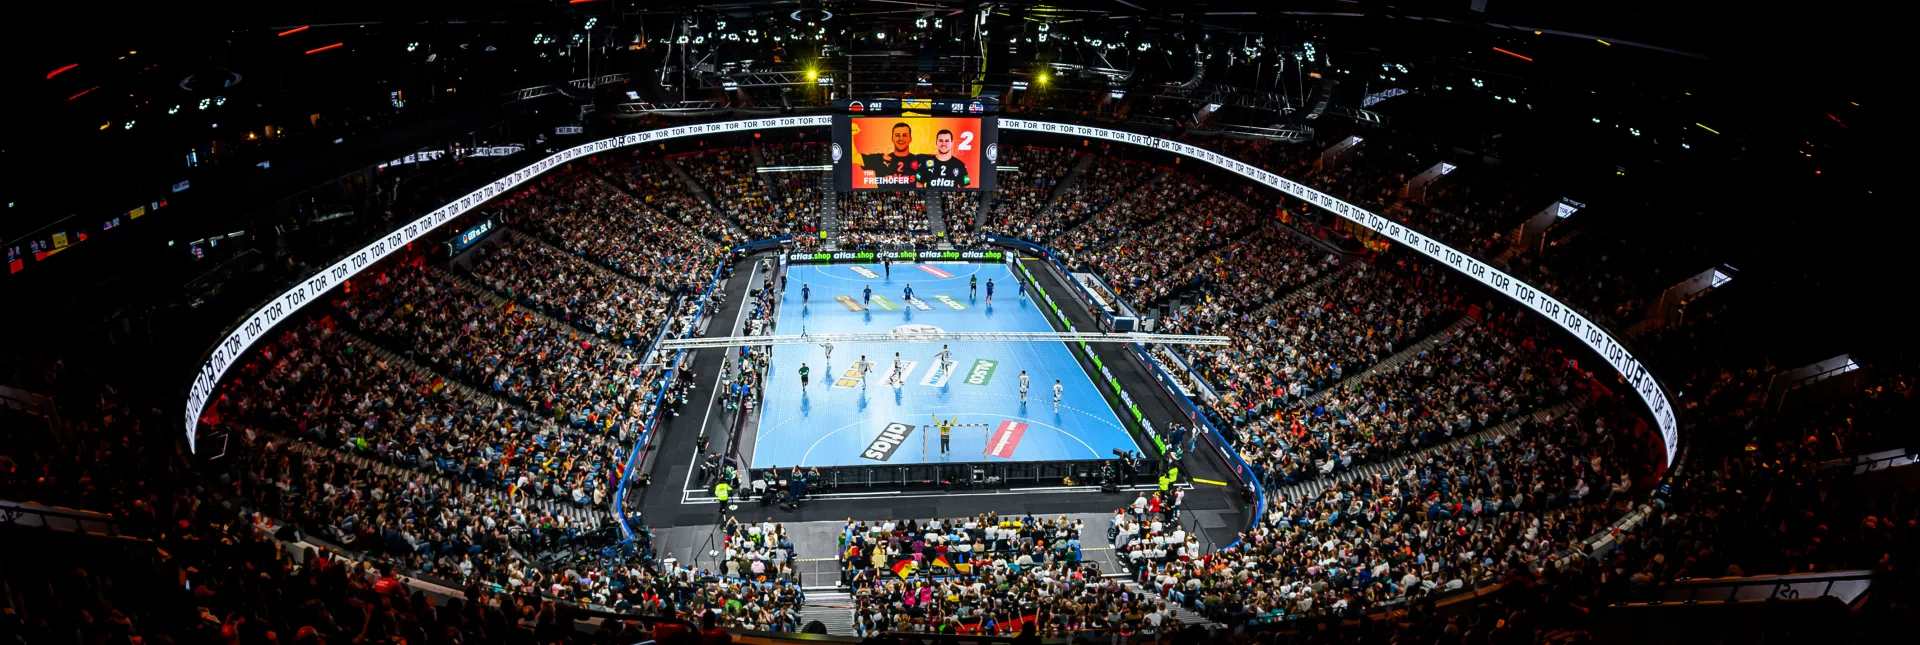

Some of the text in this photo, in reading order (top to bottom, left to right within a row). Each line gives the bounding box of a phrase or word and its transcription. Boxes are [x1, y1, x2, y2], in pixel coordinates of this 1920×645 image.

[958, 131, 974, 150] 2
[897, 161, 904, 173] 2
[940, 165, 947, 176] 2
[930, 177, 955, 187] atlas
[224, 333, 242, 360] TOR
[245, 317, 263, 340] TOR
[264, 302, 283, 324] TOR
[285, 288, 306, 309] TOR
[308, 275, 328, 296] TOR
[331, 263, 348, 281] TOR
[351, 252, 368, 270] TOR
[370, 242, 386, 259] TOR
[387, 232, 403, 249] TOR
[404, 224, 418, 240] TOR
[420, 216, 432, 231] TOR
[434, 209, 446, 223] TOR
[448, 203, 459, 217] TOR
[460, 197, 471, 210] TOR
[472, 191, 483, 204] TOR
[484, 186, 494, 198] TOR
[514, 173, 522, 182] TOR
[523, 168, 531, 177] TOR
[563, 150, 572, 159] TOR
[573, 147, 581, 156] TOR
[583, 144, 593, 153] TOR
[595, 141, 608, 150] TOR
[638, 132, 651, 141] TOR
[656, 130, 668, 138] TOR
[1042, 123, 1056, 131] TOR
[1060, 125, 1074, 133] TOR
[1078, 127, 1092, 135] TOR
[1094, 129, 1108, 137] TOR
[1112, 131, 1125, 140] TOR
[1127, 133, 1141, 143] TOR
[1171, 142, 1182, 151] TOR
[1185, 146, 1195, 155] TOR
[1196, 149, 1205, 158] TOR
[1207, 152, 1215, 161] TOR
[1216, 155, 1224, 164] TOR
[1235, 163, 1244, 172] TOR
[1246, 167, 1255, 177] TOR
[1257, 170, 1266, 181] TOR
[1268, 175, 1278, 186] TOR
[1280, 180, 1291, 191] TOR
[1293, 183, 1304, 196] TOR
[1307, 189, 1318, 202] TOR
[1321, 195, 1333, 208] TOR
[1335, 200, 1349, 216] TOR
[1352, 207, 1365, 224] TOR
[1404, 229, 1419, 246] TOR
[1424, 239, 1440, 257] TOR
[1445, 249, 1463, 268] TOR
[1467, 258, 1485, 279] TOR
[1491, 271, 1510, 291] TOR
[1515, 283, 1535, 305] TOR
[1540, 296, 1560, 320] TOR
[1563, 308, 1582, 333] TOR
[1585, 324, 1603, 349] TOR
[1604, 336, 1623, 370] TOR
[790, 252, 831, 261] atlas.shop
[833, 252, 874, 261] atlas.shop
[919, 251, 960, 260] atlas.shop
[961, 251, 1002, 260] atlas.shop
[865, 423, 907, 460] atlas
